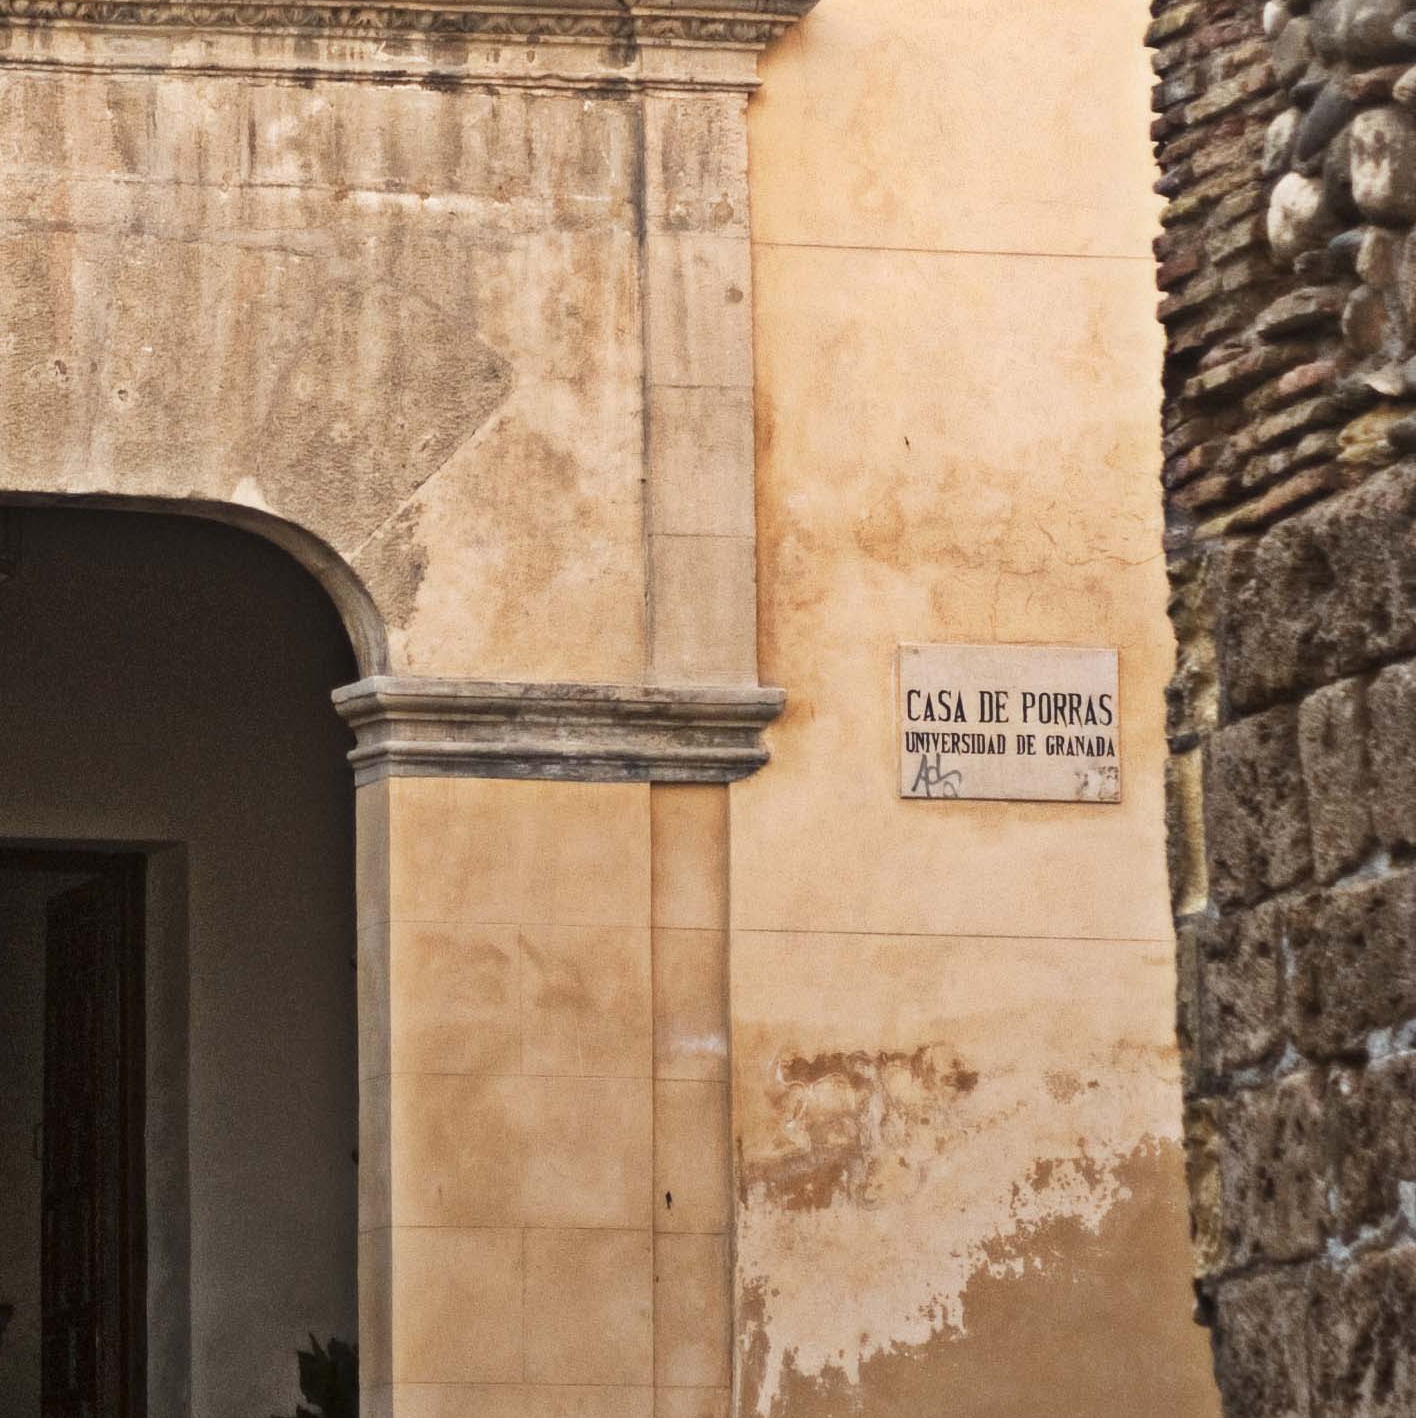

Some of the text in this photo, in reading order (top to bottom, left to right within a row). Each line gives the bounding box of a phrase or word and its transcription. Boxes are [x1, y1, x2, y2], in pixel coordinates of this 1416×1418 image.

[906, 689, 1113, 728] CASA DE PORRAS
[905, 731, 1116, 757] UNIVERSIDAD DE GRANADA
